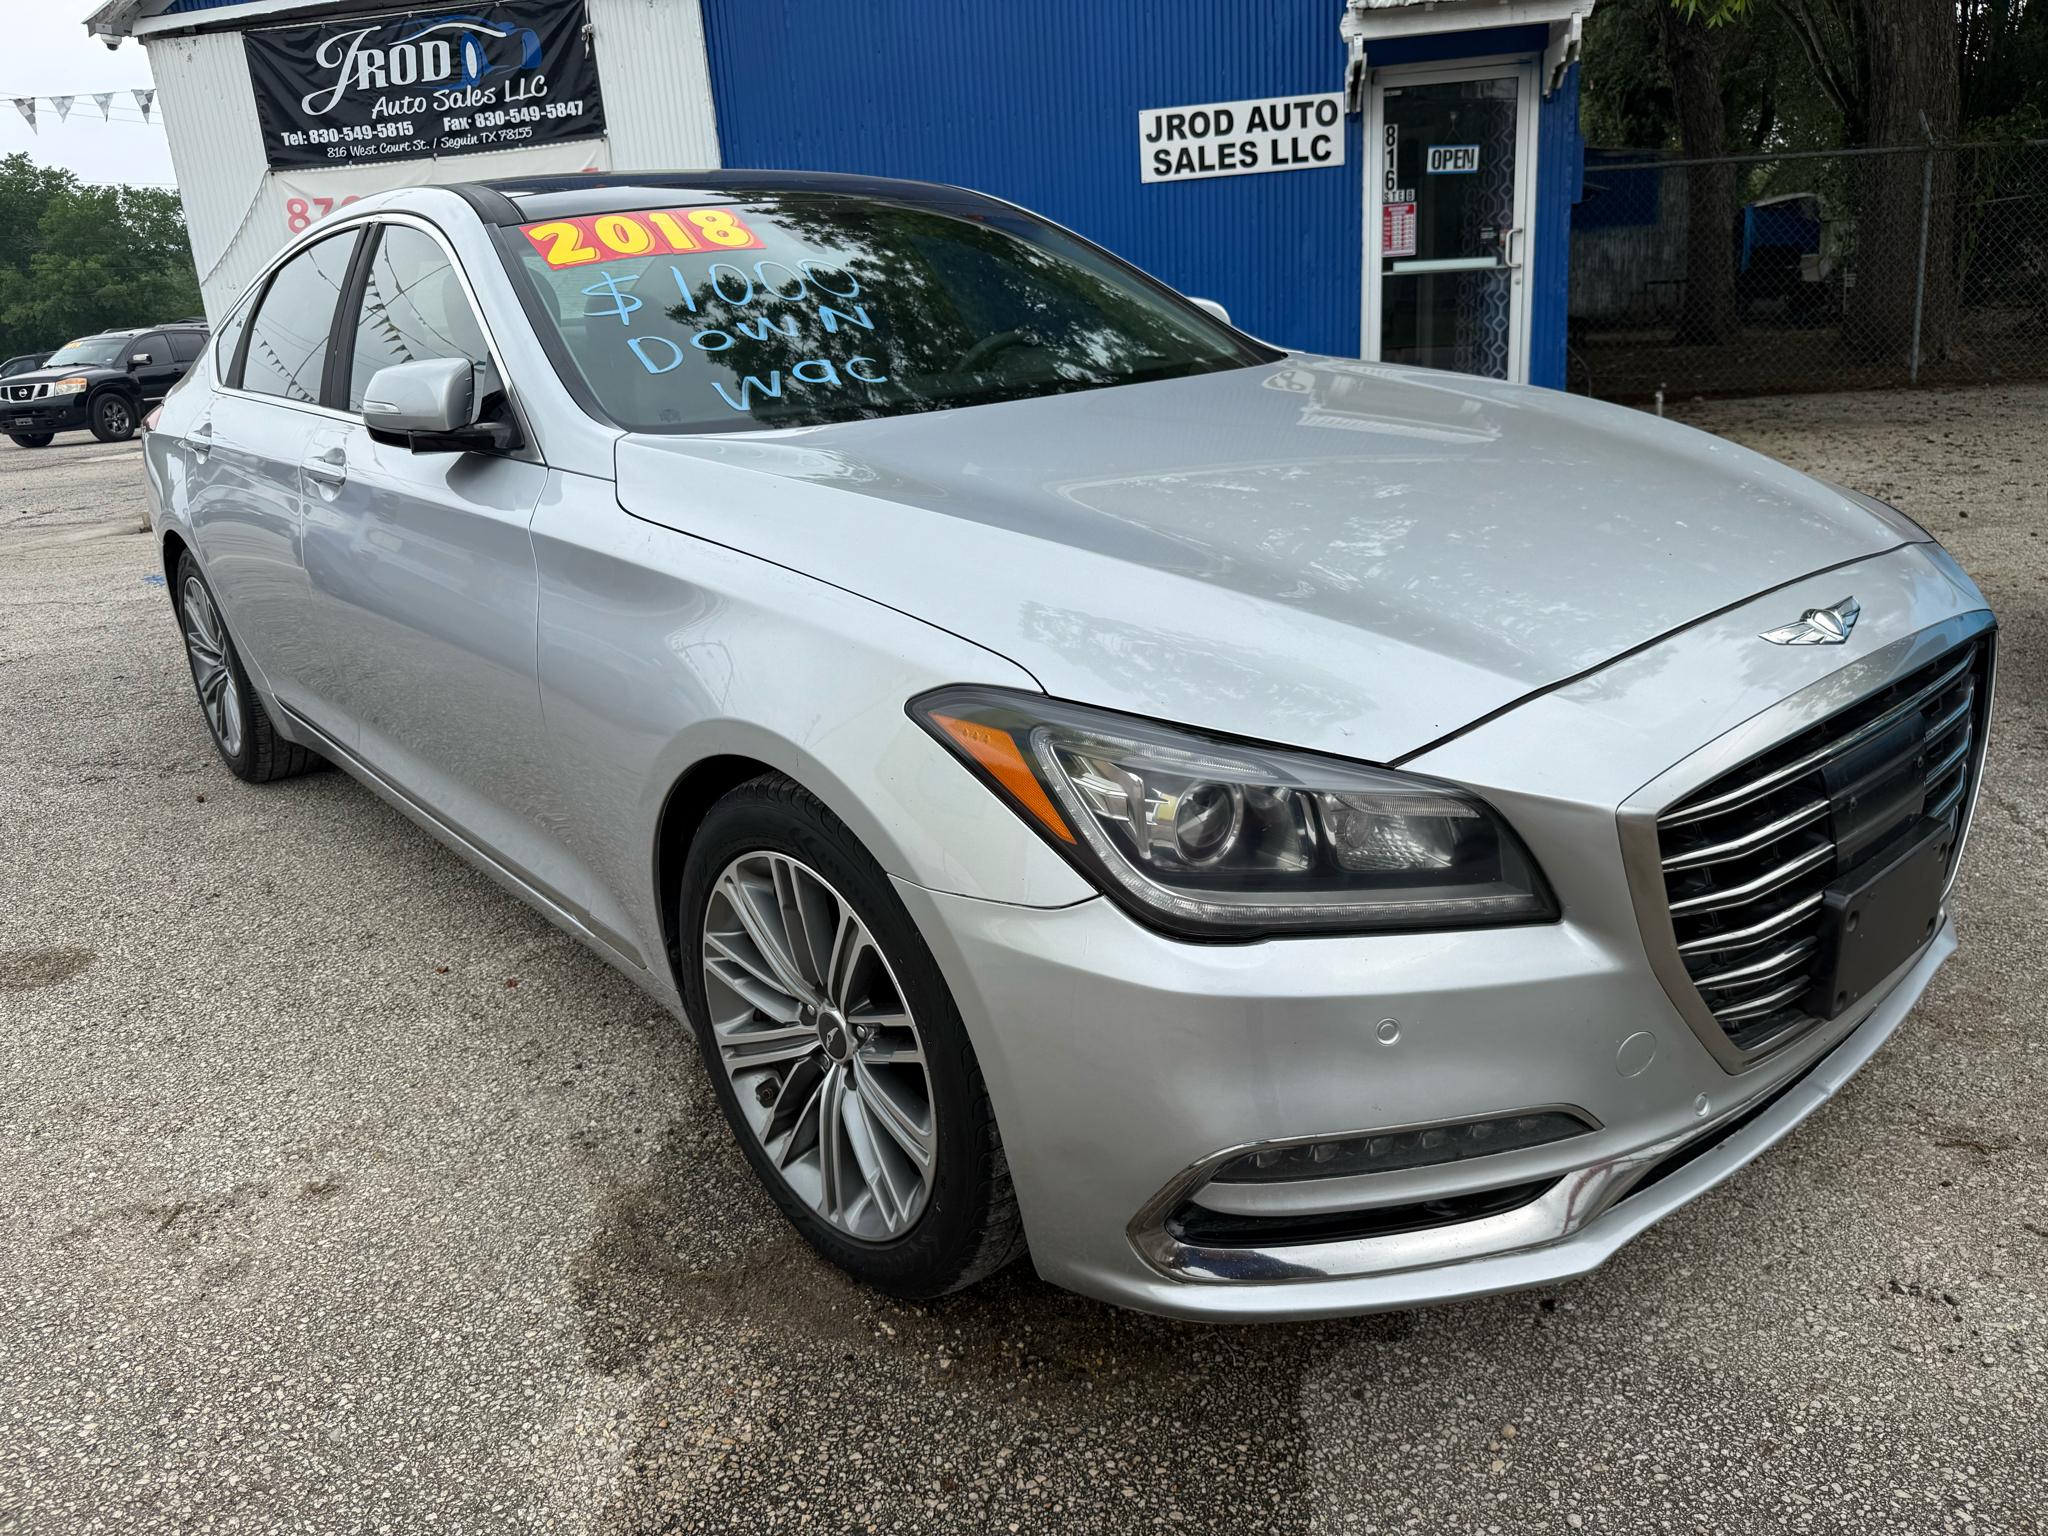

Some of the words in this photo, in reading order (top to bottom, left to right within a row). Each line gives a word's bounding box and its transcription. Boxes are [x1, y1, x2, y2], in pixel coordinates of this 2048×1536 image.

[301, 25, 451, 116] JROD
[371, 96, 427, 119] Auto
[433, 84, 496, 111] Sales
[503, 74, 548, 103] LLC
[474, 100, 583, 128] 830-549-5847
[280, 130, 308, 147] Tel:
[308, 121, 414, 145] 830-549-5815
[327, 146, 347, 158] 816
[350, 144, 378, 157] West
[379, 140, 411, 154] Court
[412, 139, 430, 151] St.
[440, 133, 479, 150] Seguin
[480, 131, 498, 144] TX
[498, 126, 533, 142] 78155
[1145, 109, 1235, 143] JROD
[1246, 99, 1339, 134] AUTO
[1153, 141, 1258, 176] SALES
[1271, 134, 1332, 166] LLC
[1385, 125, 1396, 191] 816
[1431, 148, 1475, 170] OPEN
[527, 208, 756, 266] 2018
